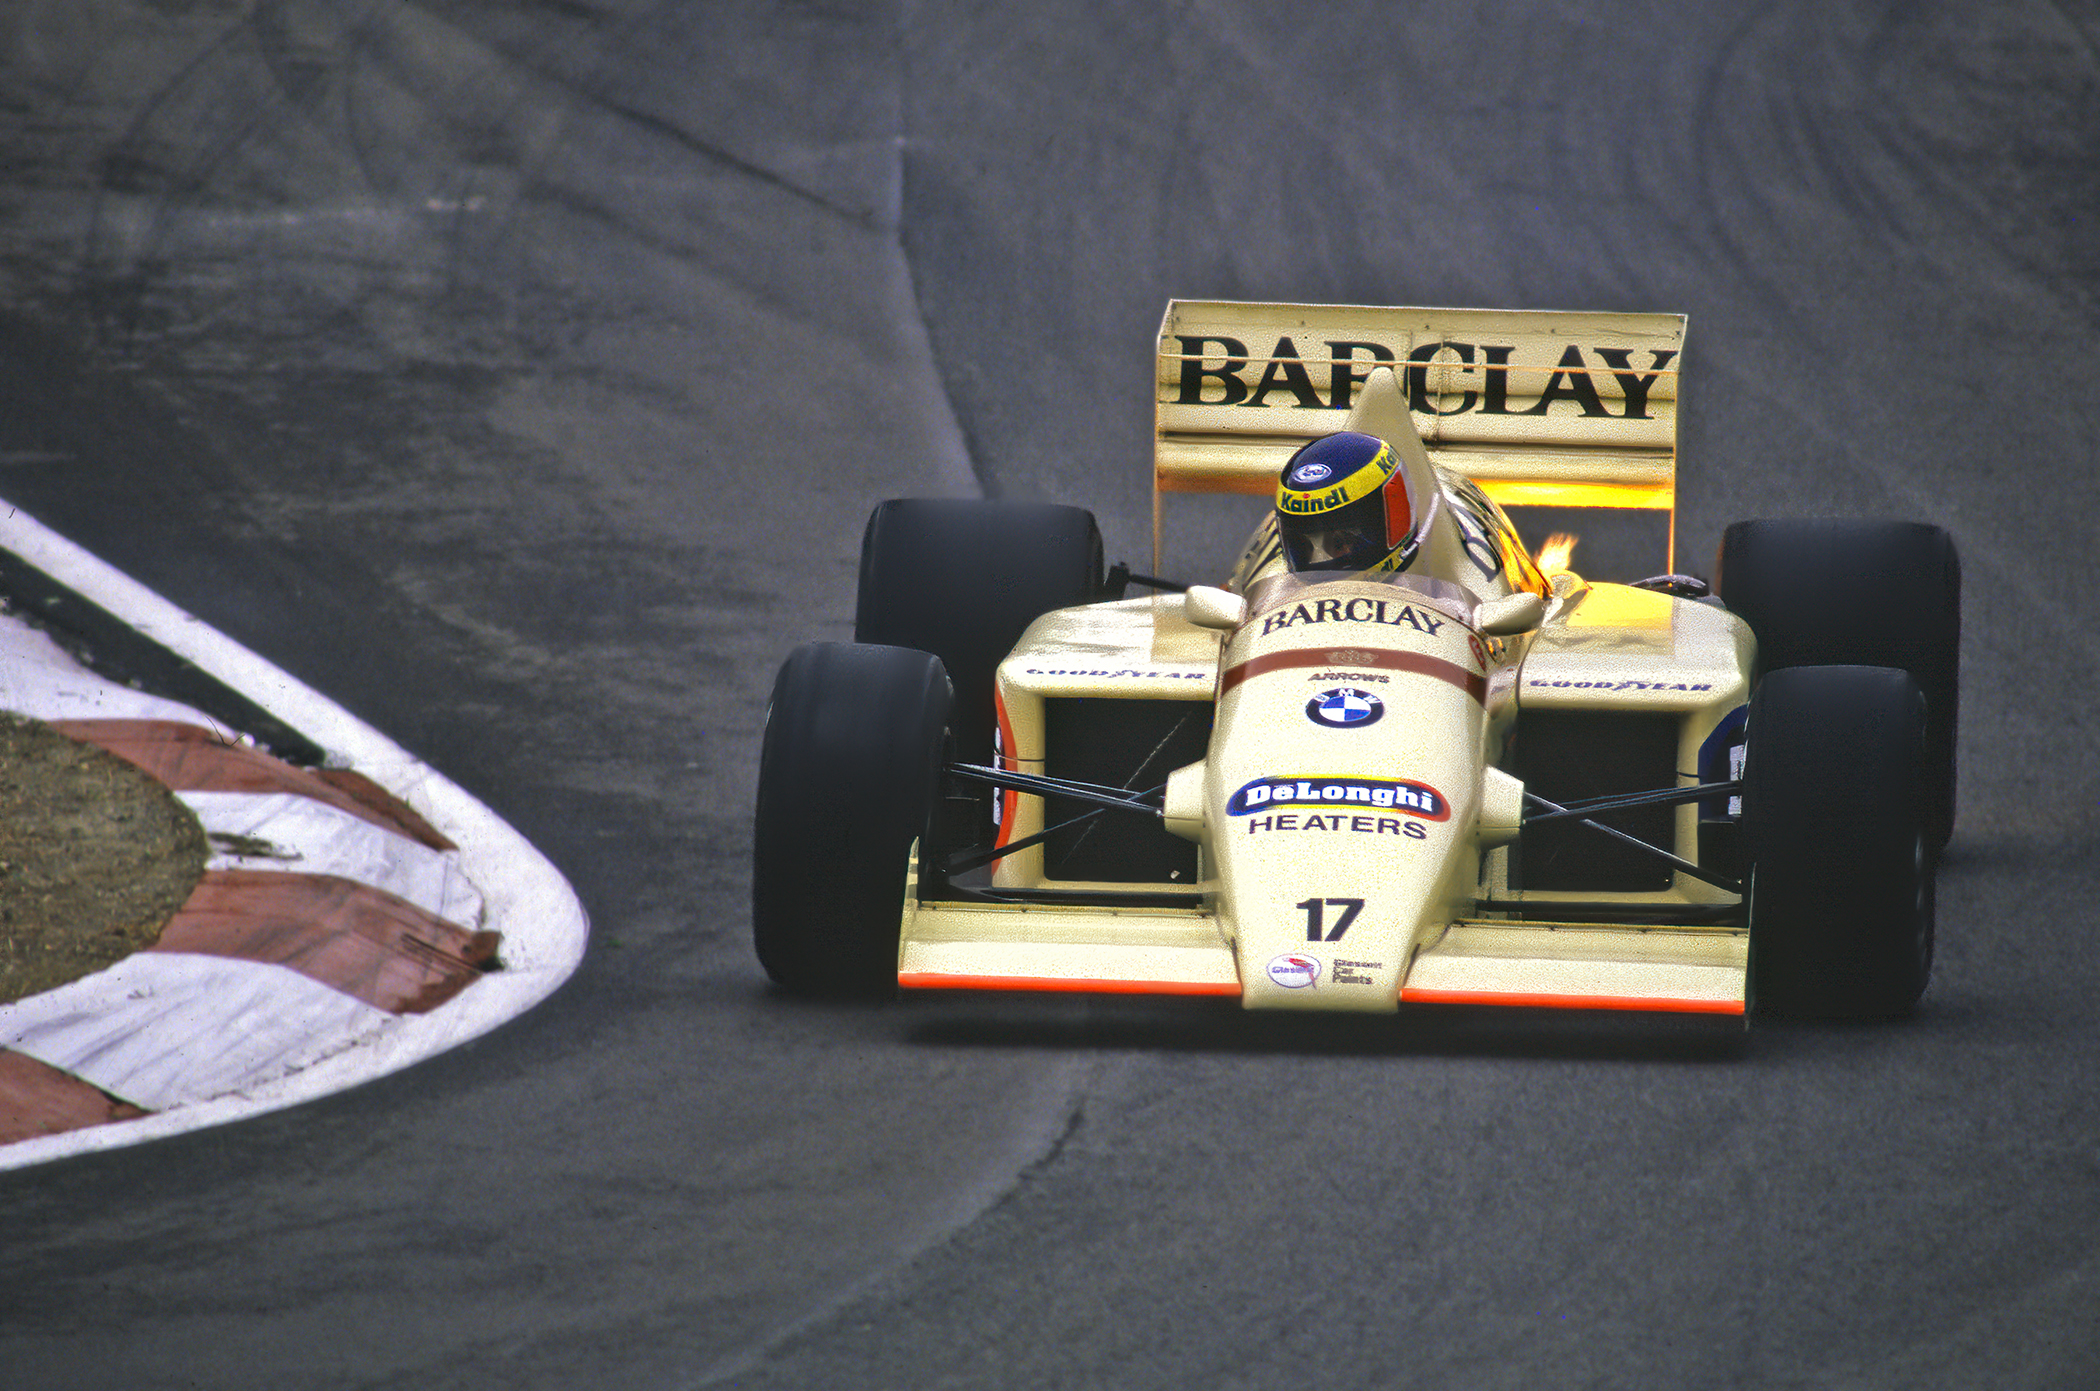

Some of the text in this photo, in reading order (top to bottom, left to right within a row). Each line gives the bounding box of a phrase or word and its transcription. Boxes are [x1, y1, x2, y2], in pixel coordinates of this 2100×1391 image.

[1175, 334, 1678, 420] BARCLAY
[1281, 486, 1350, 512] Kaindl
[1261, 598, 1445, 637] BARCLAY
[1307, 672, 1390, 684] ARROWS
[1314, 688, 1382, 704] BMW
[1245, 781, 1434, 812] DeLonghi
[1248, 814, 1428, 840] HEATERS
[1296, 897, 1366, 941] 17
